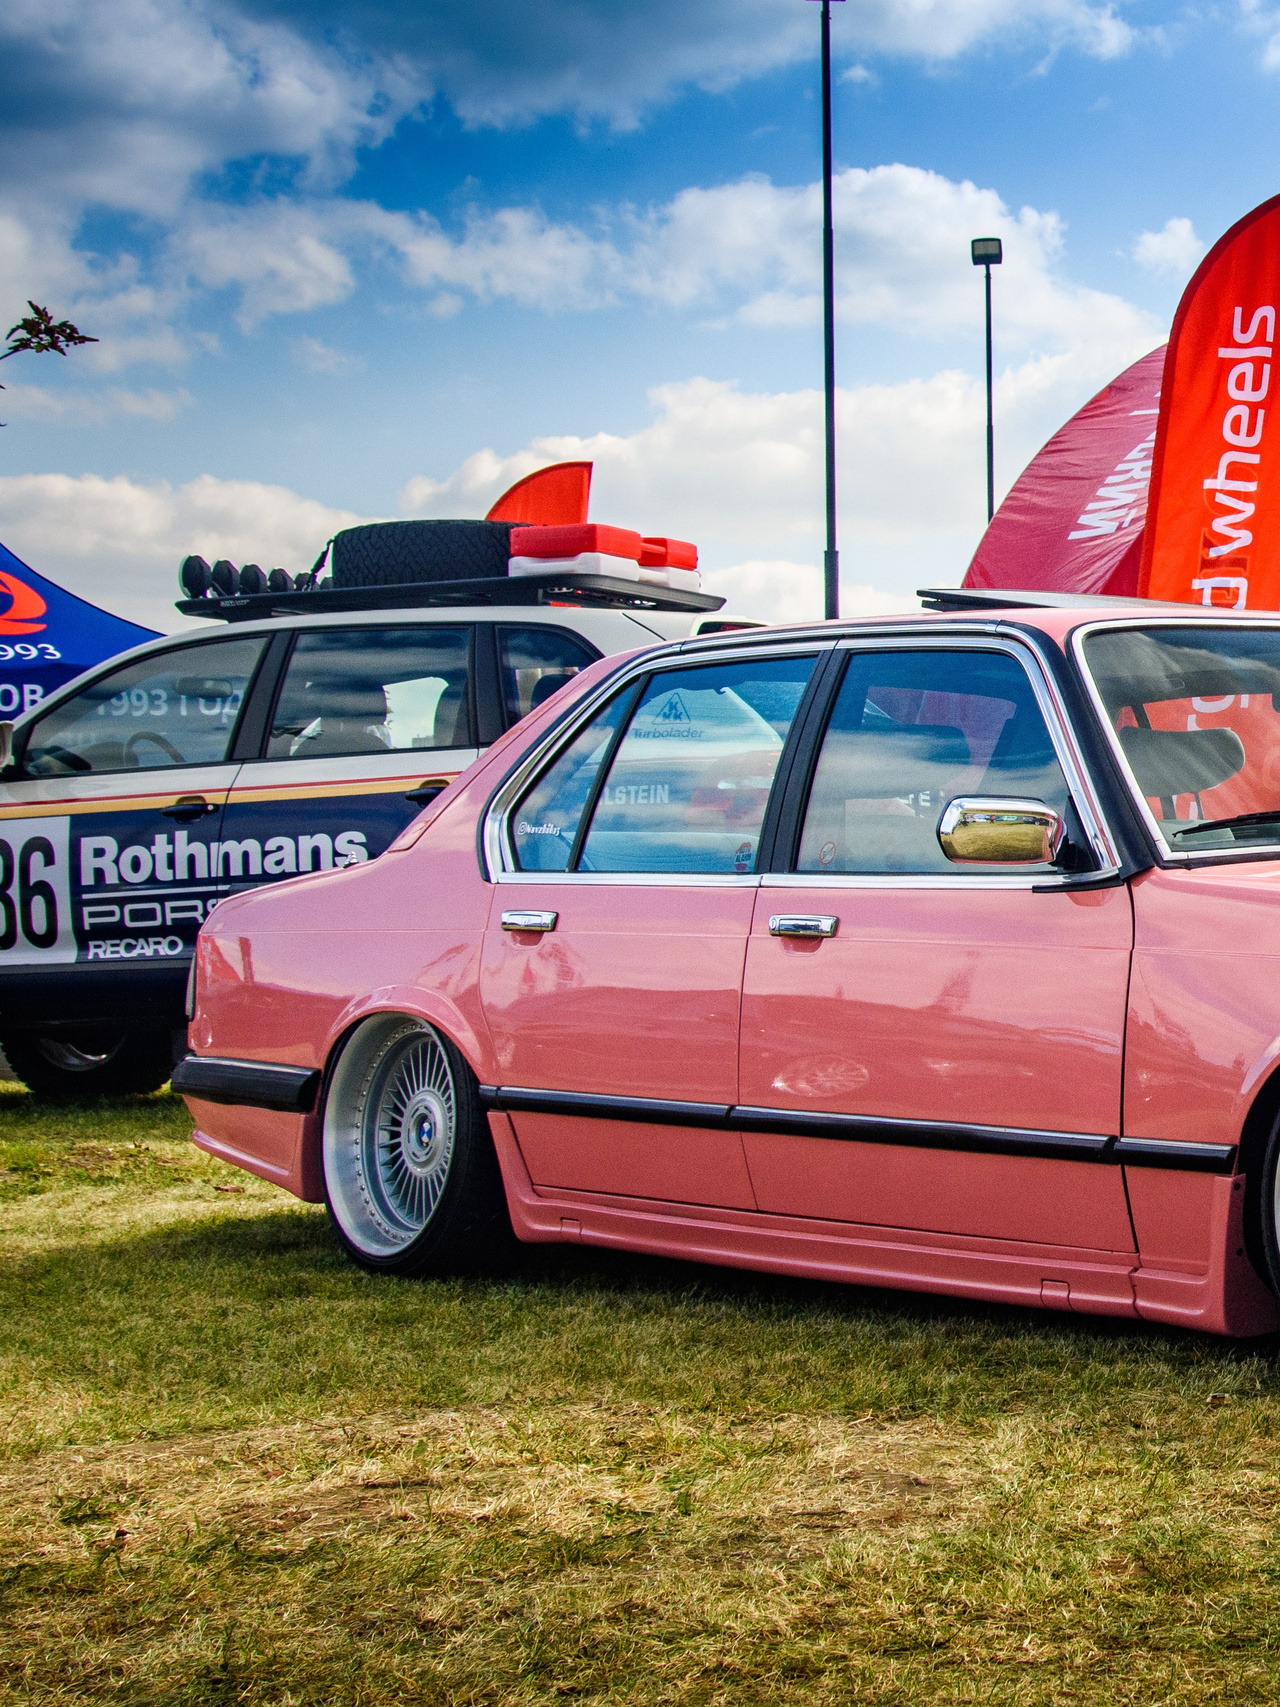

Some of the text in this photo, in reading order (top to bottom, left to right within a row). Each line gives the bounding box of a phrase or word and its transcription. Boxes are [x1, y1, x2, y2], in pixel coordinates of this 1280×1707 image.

[1203, 305, 1276, 558] wheels
[598, 784, 669, 806] LSTEIN
[80, 830, 368, 886] Rothmans
[83, 898, 219, 930] POR
[88, 936, 184, 960] RECARO
